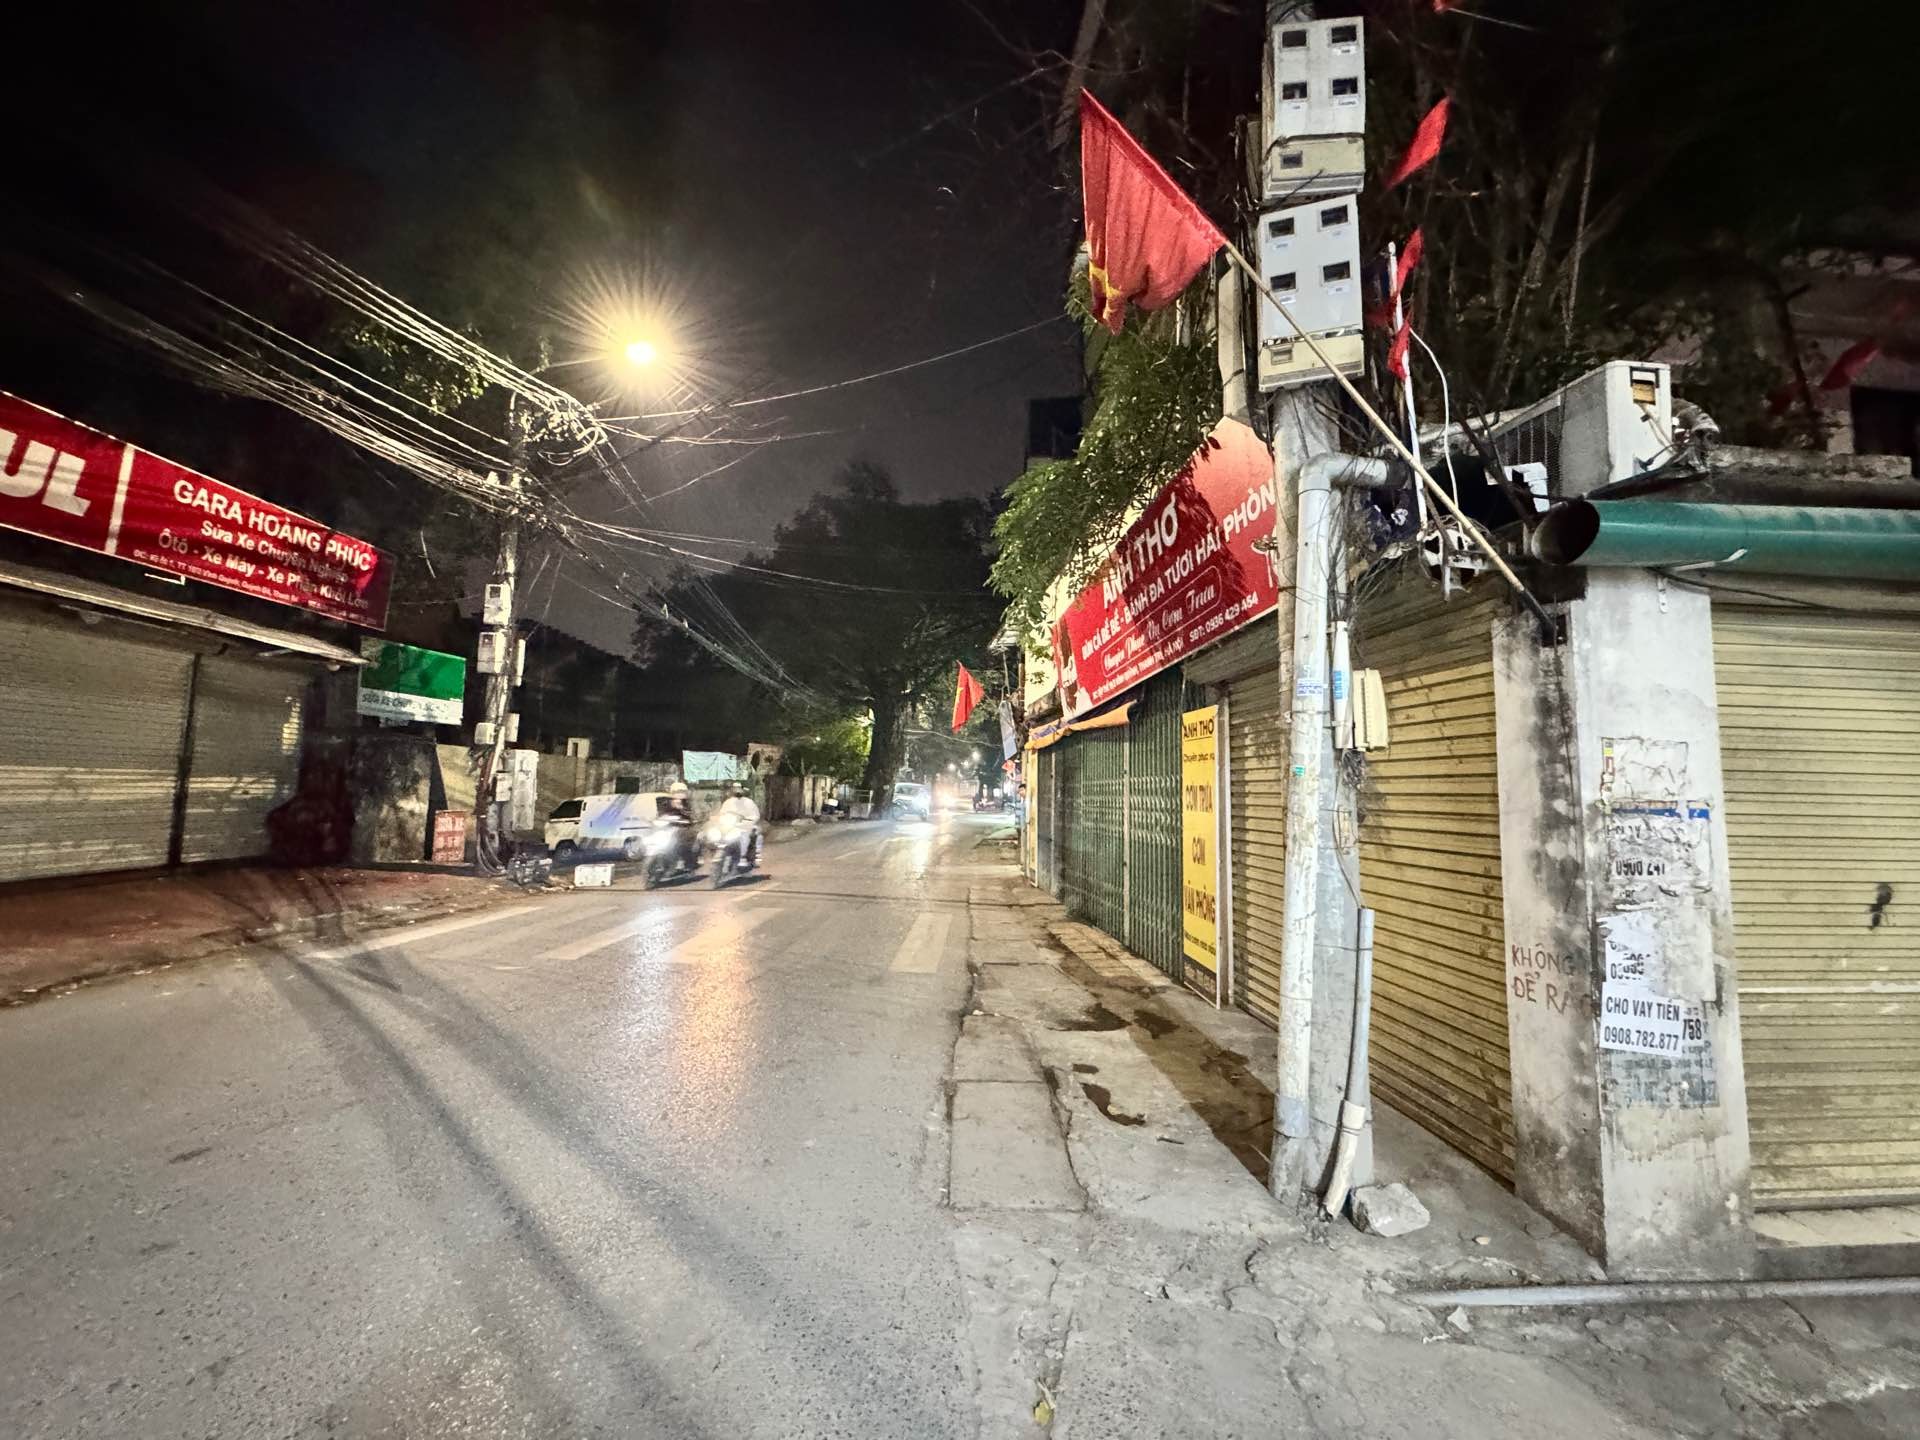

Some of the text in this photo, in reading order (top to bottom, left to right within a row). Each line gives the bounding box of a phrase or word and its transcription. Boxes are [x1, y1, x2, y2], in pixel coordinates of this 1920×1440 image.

[173, 480, 372, 571] GARA HOÀNG PHÚC
[201, 520, 233, 544] Sửa
[236, 531, 256, 550] Xe
[202, 546, 222, 564] Xe
[226, 553, 256, 578] Máy
[266, 566, 284, 584] Xe
[1103, 492, 1178, 608] ANH THƠ
[1123, 586, 1149, 625] BÁNH
[1148, 577, 1165, 603] ĐA
[1164, 548, 1194, 589] TƯƠI
[1195, 522, 1222, 566] HẢI
[1222, 478, 1277, 543] PHÒN
[1183, 721, 1198, 738] ANH
[1511, 942, 1577, 977] KHÔNG
[1605, 996, 1629, 1015] CHO
[1632, 999, 1653, 1018] VAY
[1603, 1025, 1679, 1052] 0908.782.877
